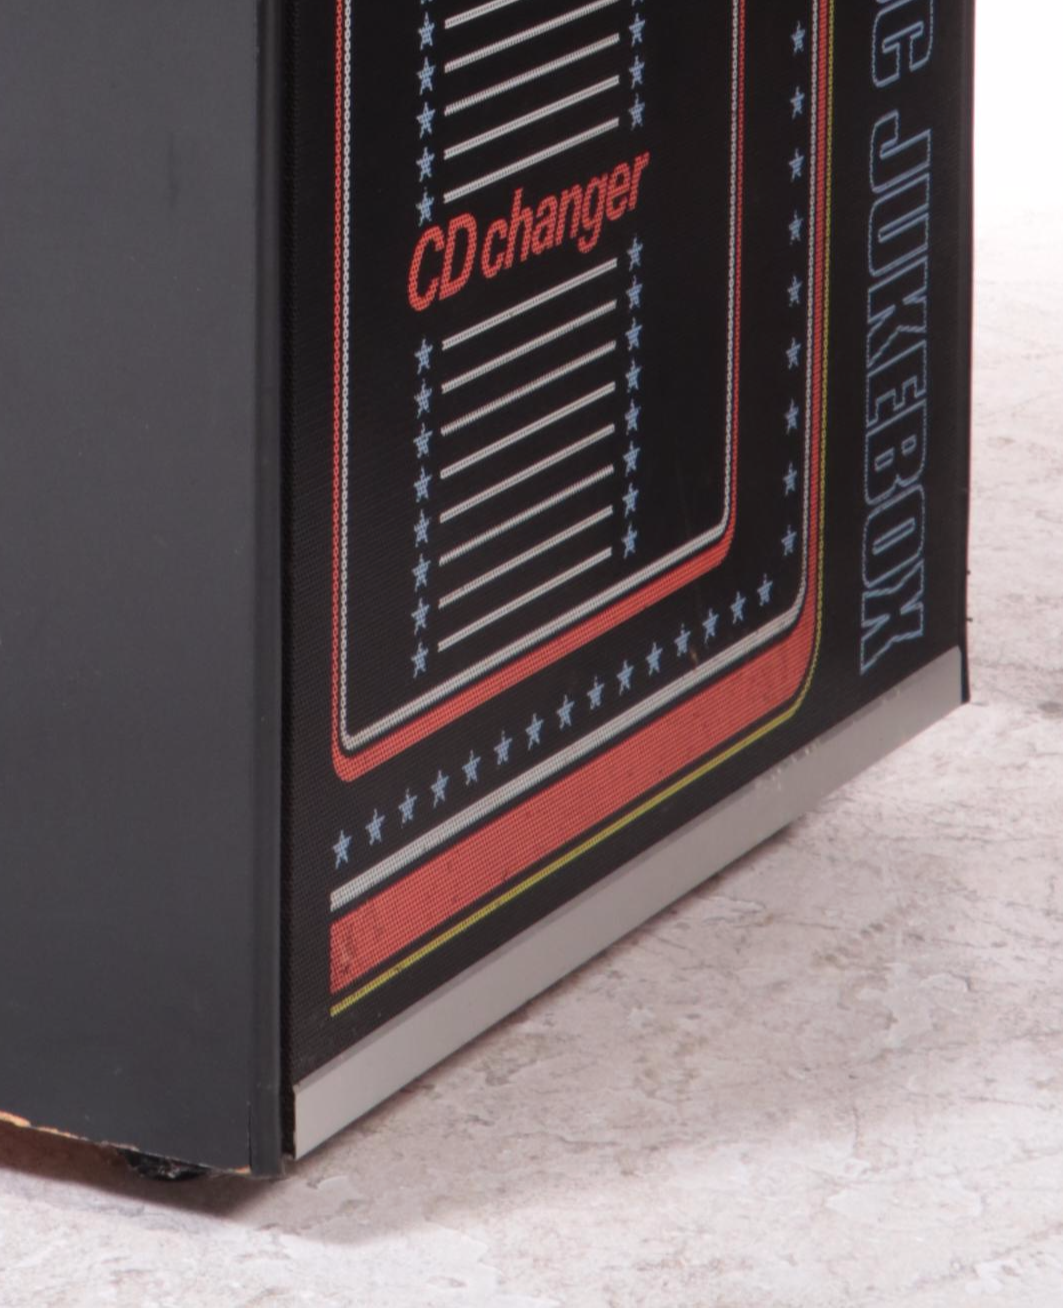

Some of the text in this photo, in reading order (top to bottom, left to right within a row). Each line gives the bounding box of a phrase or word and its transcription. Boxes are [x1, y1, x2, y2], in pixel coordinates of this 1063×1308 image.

[406, 151, 650, 313] CD changer
[859, 107, 934, 677] JUKEBOX
